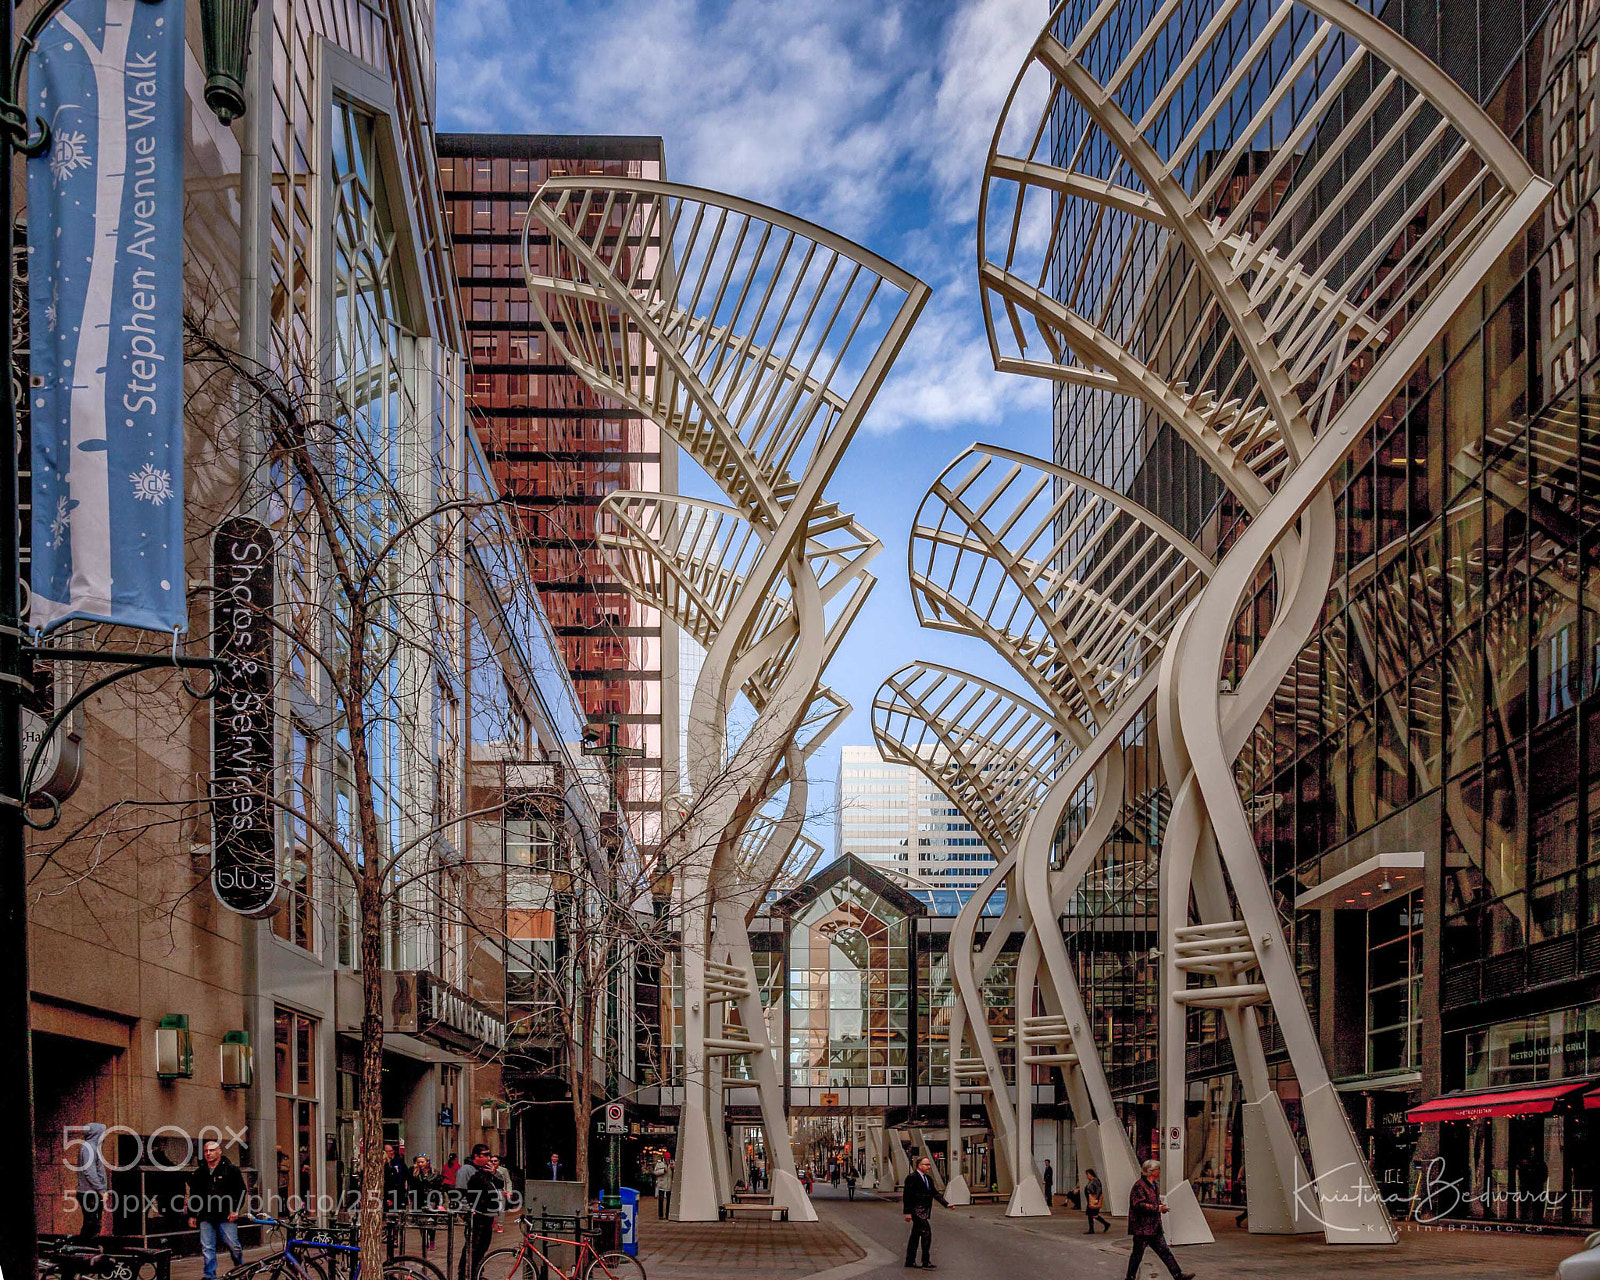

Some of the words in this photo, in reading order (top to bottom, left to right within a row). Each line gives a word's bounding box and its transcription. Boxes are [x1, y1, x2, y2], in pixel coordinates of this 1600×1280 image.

[126, 50, 157, 130] Walk
[126, 136, 156, 260] Avenue
[122, 271, 165, 415] Stephen
[223, 542, 263, 647] Shops
[231, 660, 258, 681] &
[231, 691, 262, 830] Services
[1510, 1045, 1563, 1061] METROPOLITAN
